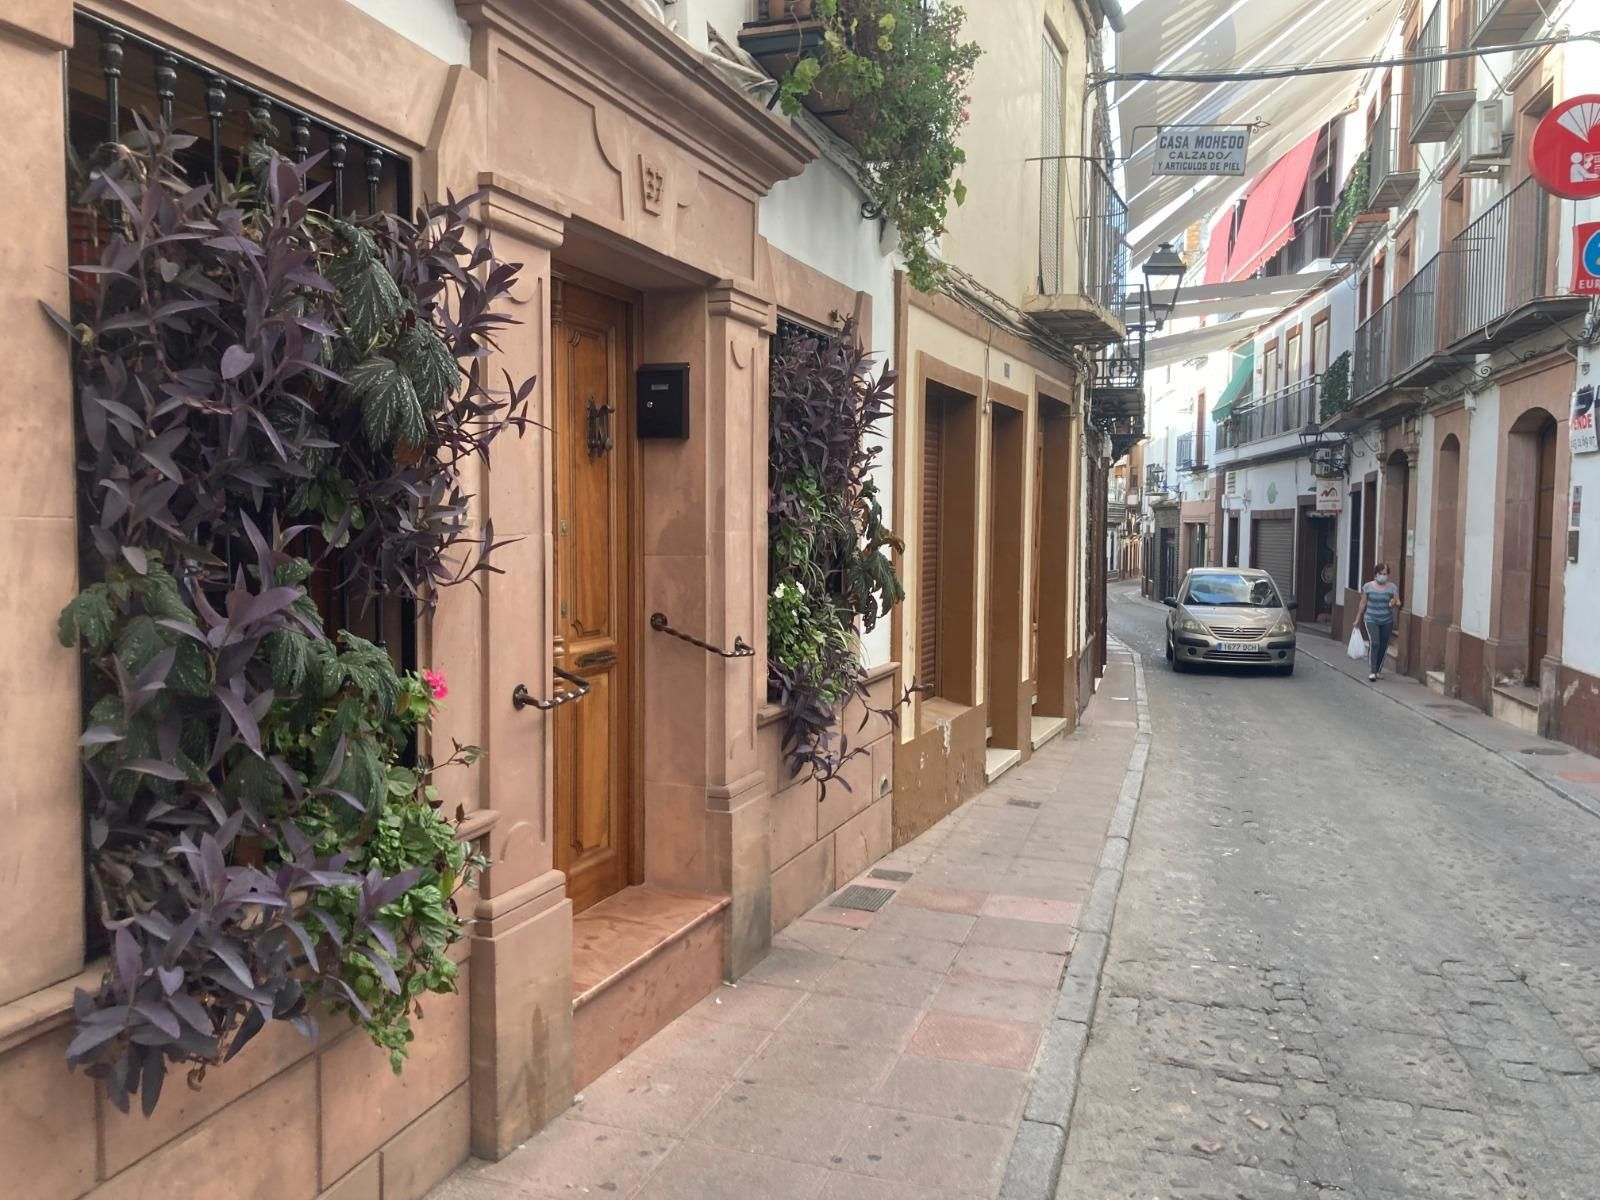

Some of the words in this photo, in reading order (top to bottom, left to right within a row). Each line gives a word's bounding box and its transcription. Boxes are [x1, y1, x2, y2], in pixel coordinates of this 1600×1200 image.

[1160, 135, 1189, 149] CASA
[1195, 135, 1245, 149] MOHEDO
[1158, 162, 1163, 170] Y
[1165, 161, 1207, 171] ARTICULOS
[1210, 162, 1220, 171] DE
[1223, 162, 1241, 171] PIEL
